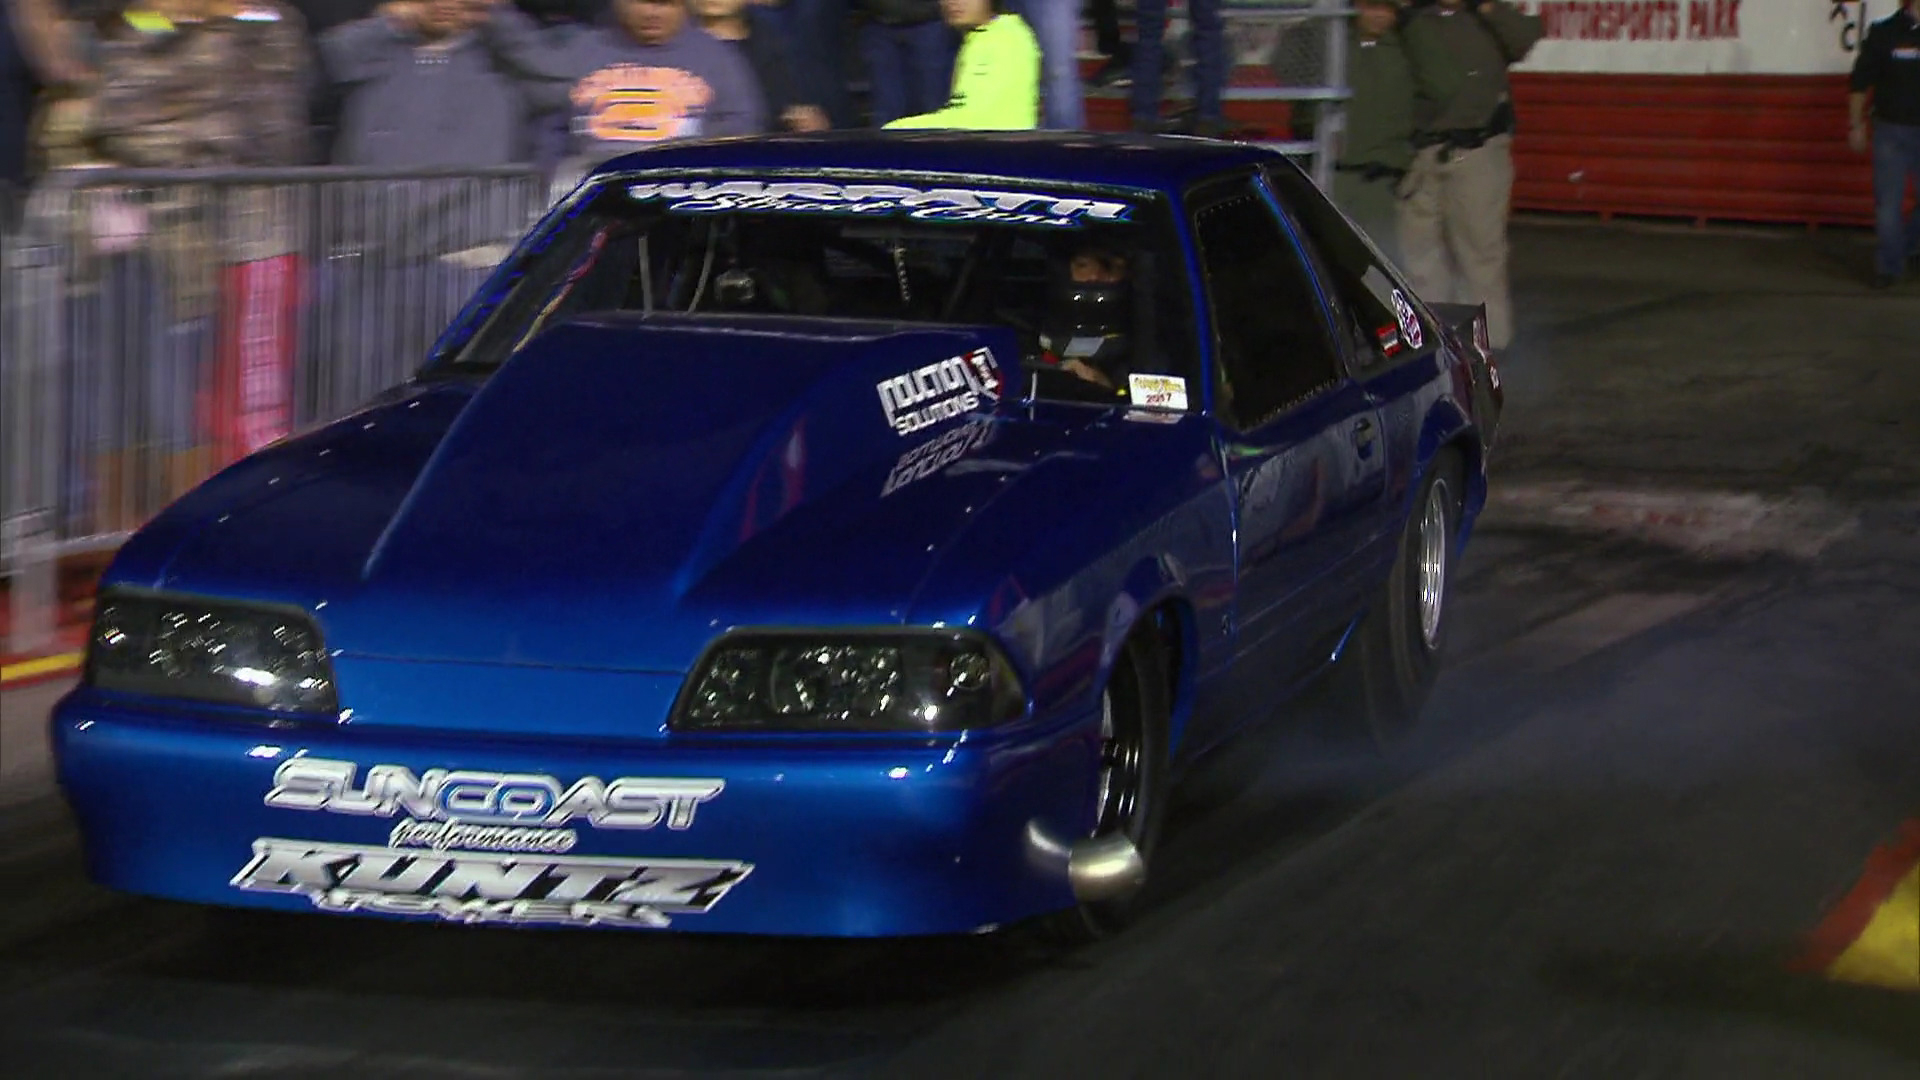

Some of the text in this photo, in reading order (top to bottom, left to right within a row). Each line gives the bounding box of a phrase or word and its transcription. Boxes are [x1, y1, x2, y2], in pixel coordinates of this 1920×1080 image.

[894, 391, 980, 436] SOLUTIONS
[264, 757, 726, 830] SUNCOAST
[388, 817, 578, 852] performance
[229, 836, 757, 914] KUNTZ
